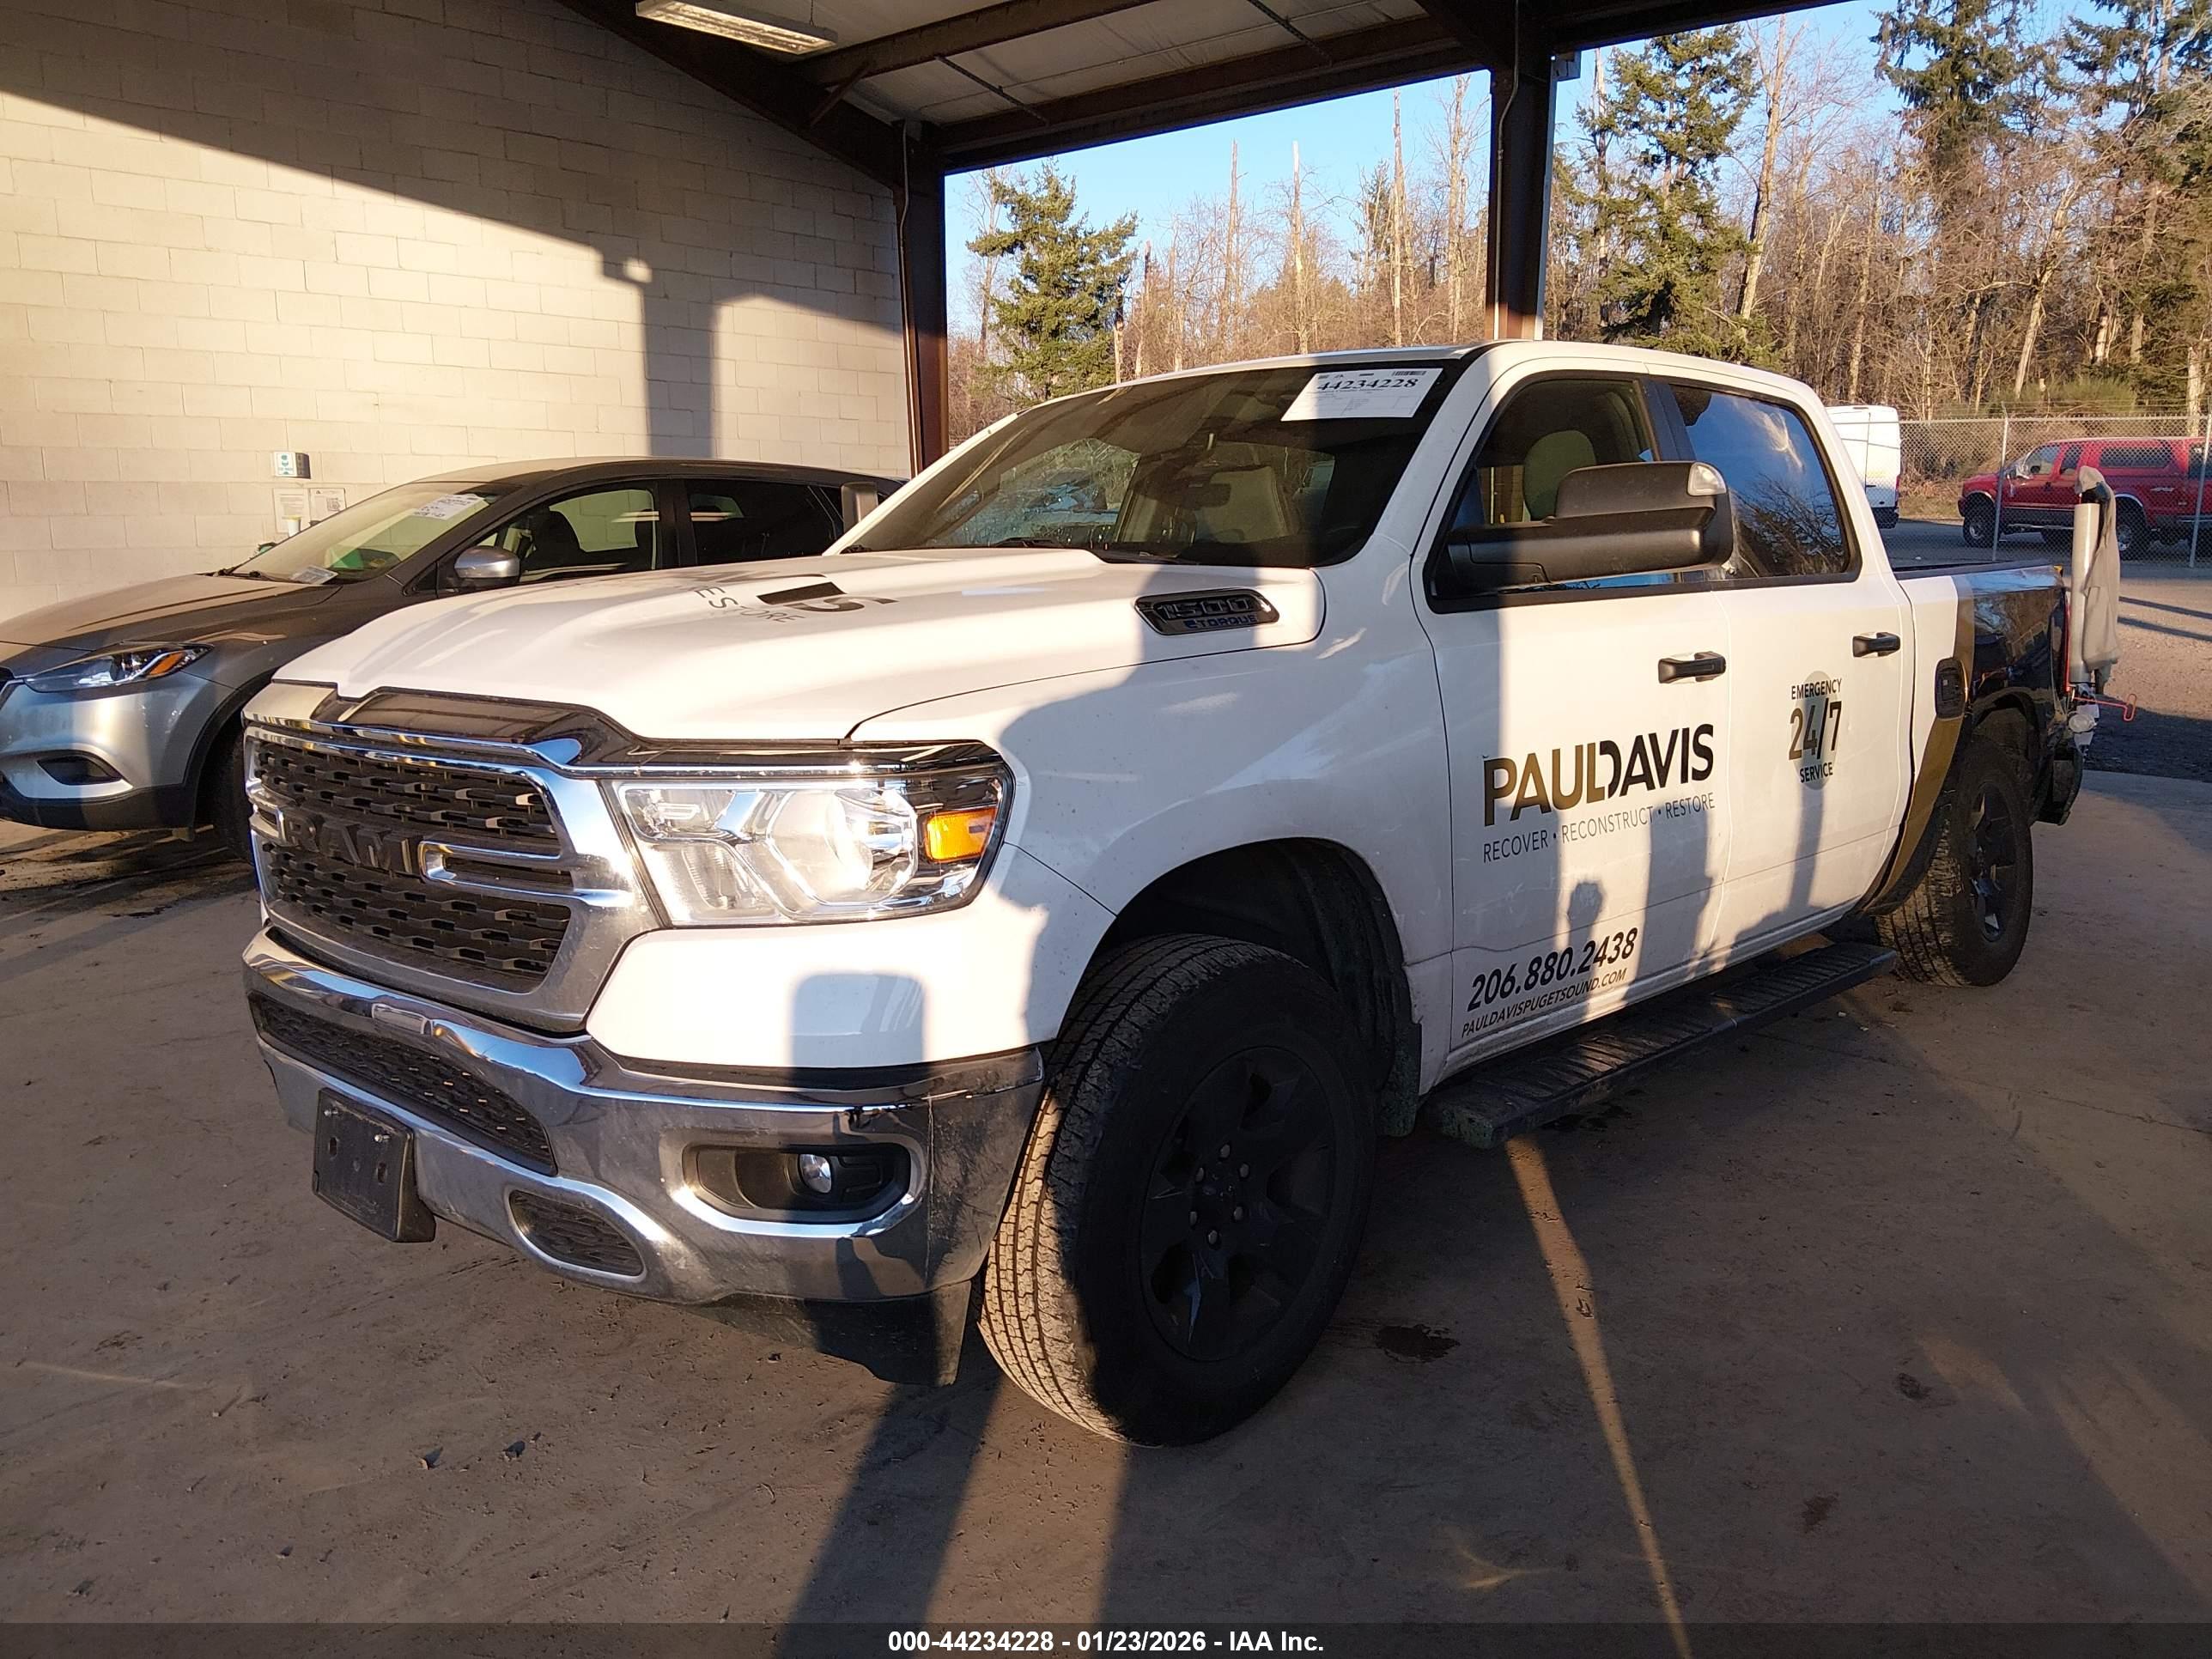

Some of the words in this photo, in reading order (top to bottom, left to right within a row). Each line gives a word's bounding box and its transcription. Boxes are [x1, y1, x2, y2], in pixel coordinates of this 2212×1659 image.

[1317, 379, 1419, 390] 44234228
[1158, 598, 1250, 618] 1500
[1791, 678, 1842, 700] EMERGENCY
[1789, 698, 1842, 760] 24/7
[1799, 763, 1833, 782] SERVICE
[1483, 830, 1548, 862] RECOVER
[1562, 805, 1655, 843] RECONSTRUCT
[1666, 793, 1716, 819] RESTORE
[1468, 927, 1638, 1012] 206.880.2438
[1462, 968, 1627, 1037] PAULDAVISPUGETSOUND.COM
